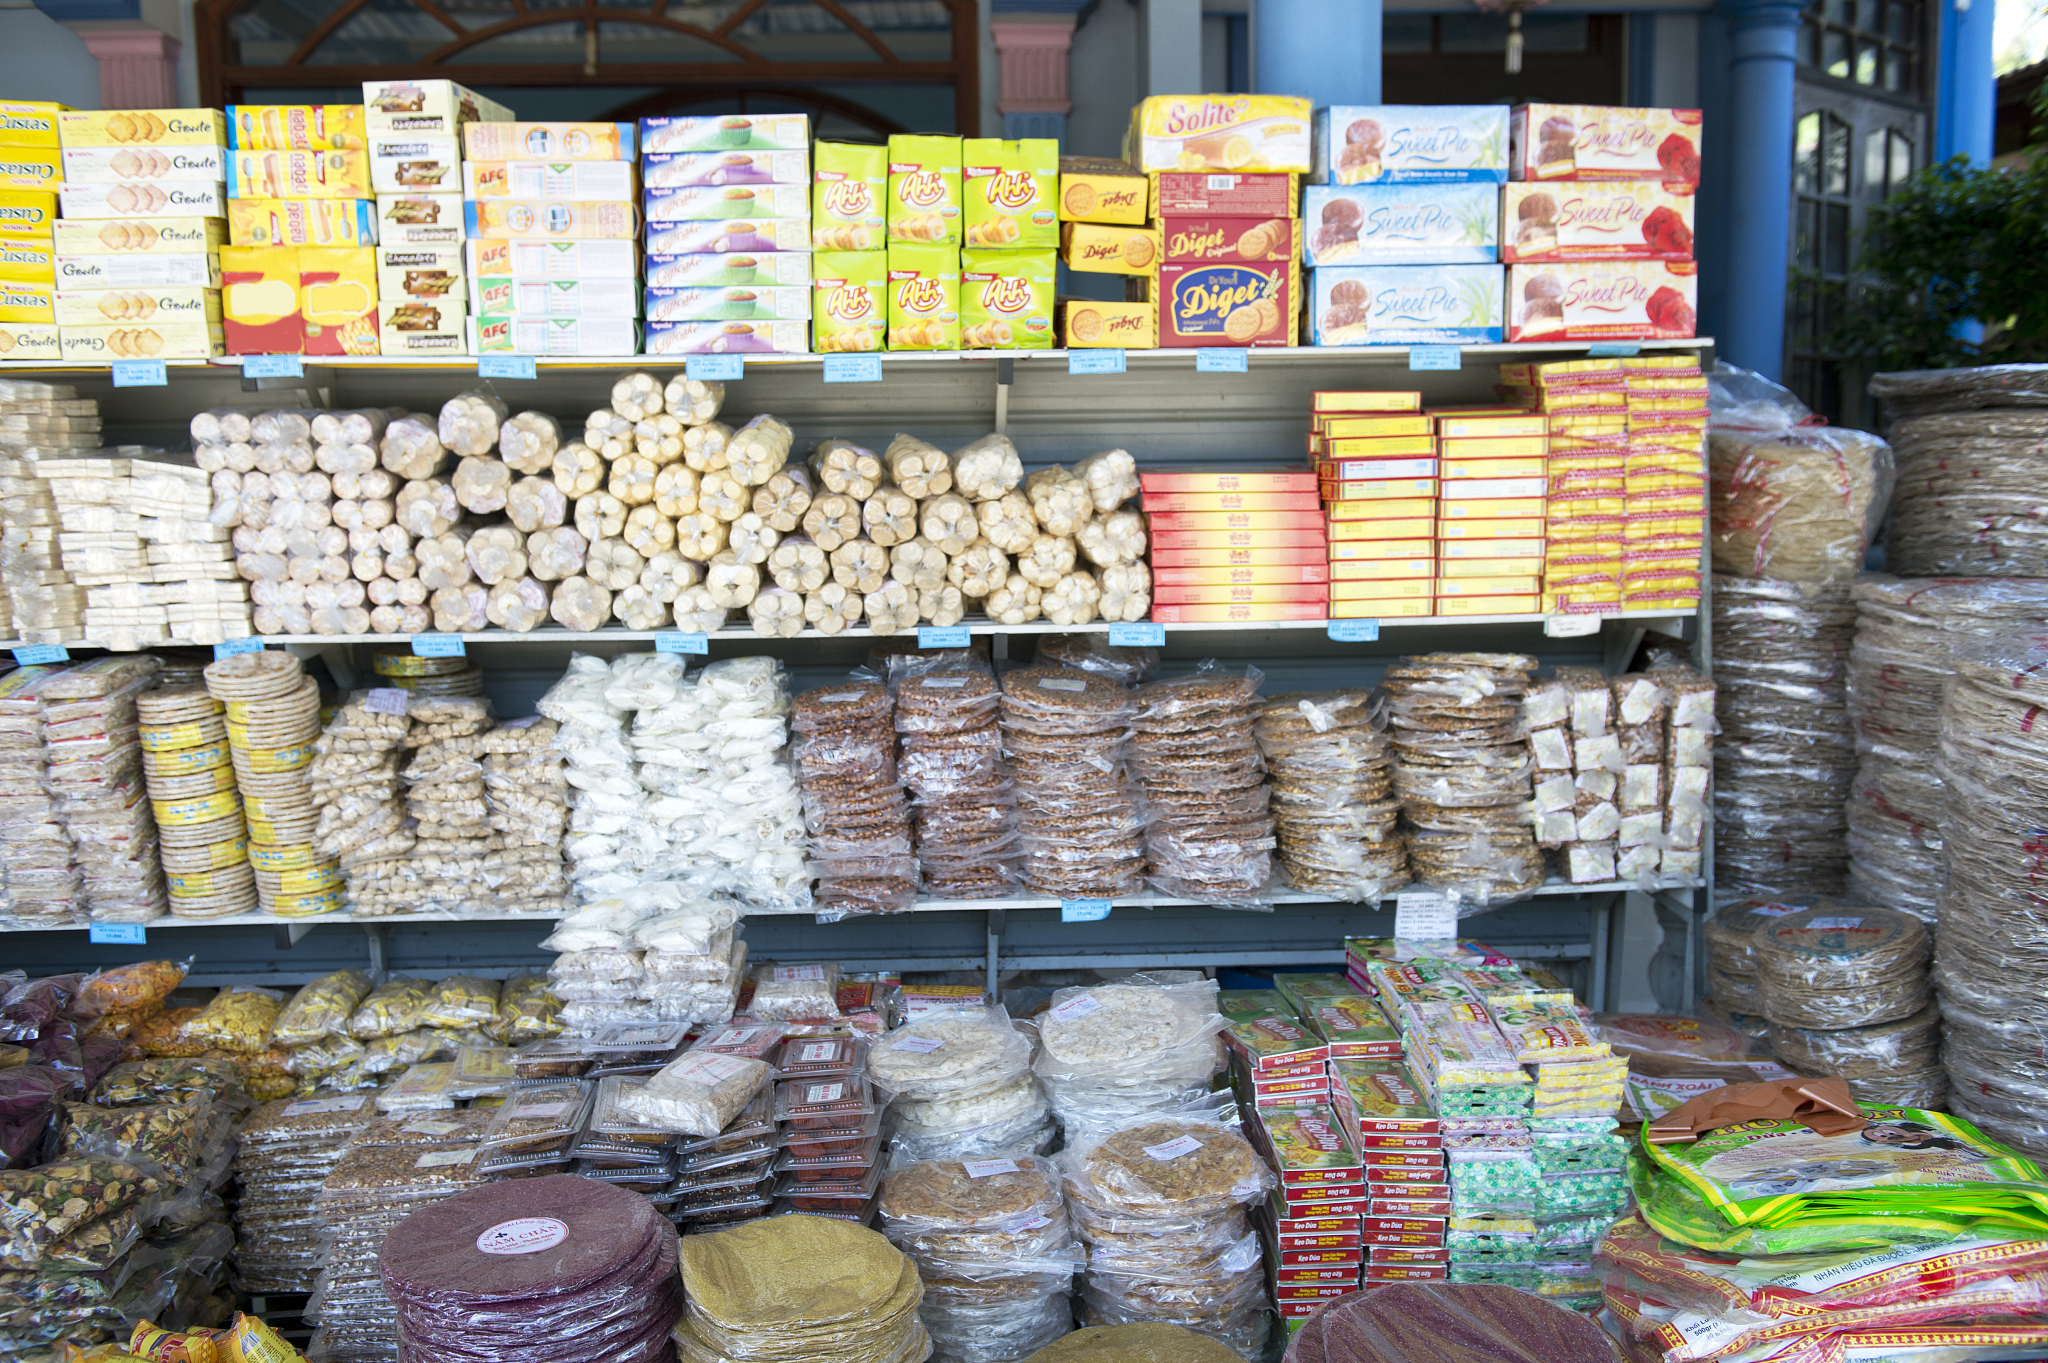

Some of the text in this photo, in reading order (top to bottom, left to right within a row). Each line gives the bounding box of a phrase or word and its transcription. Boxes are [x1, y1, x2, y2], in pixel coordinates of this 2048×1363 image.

[1166, 99, 1238, 134] Solite
[1389, 125, 1470, 157] Sweet Pie
[1578, 121, 1658, 150] Sweet Pie
[1102, 191, 1138, 208] Diget
[1559, 195, 1646, 227] Sweet Pie
[1367, 202, 1454, 236] Sweet Pie
[1083, 244, 1119, 260] Diget
[1167, 228, 1225, 257] Diget
[1179, 278, 1260, 318] Diget
[1374, 285, 1459, 317] Sweet Pie
[1564, 275, 1649, 307] Sweet Pie
[1109, 315, 1144, 332] Diget
[1841, 1261, 1863, 1273] HIỆU
[1693, 1325, 1712, 1337] 500gr
